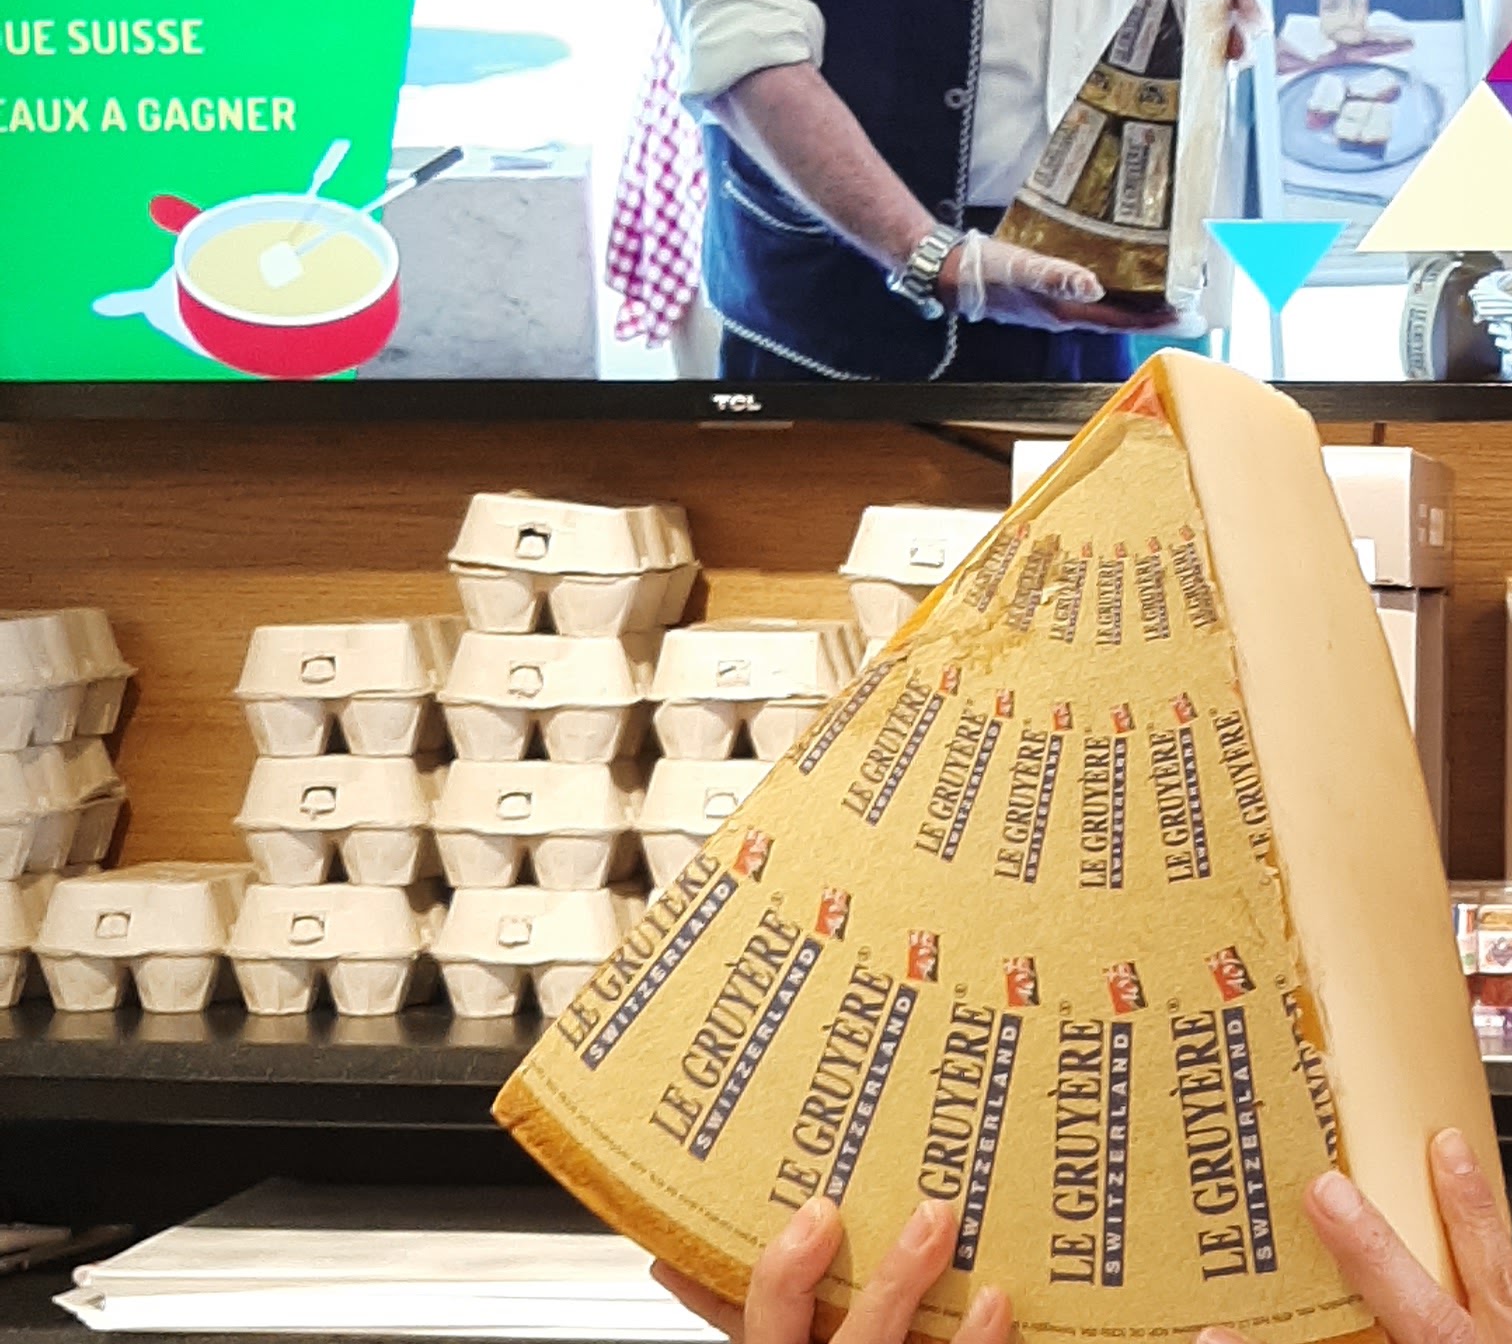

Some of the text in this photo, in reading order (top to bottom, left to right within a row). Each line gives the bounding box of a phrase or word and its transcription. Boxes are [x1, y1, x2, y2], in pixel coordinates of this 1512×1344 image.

[0, 18, 205, 56] UE SUISSE
[101, 97, 128, 133] A
[137, 96, 297, 134] GAGNER
[712, 393, 763, 412] TCL
[841, 675, 934, 818] LE GRUYÈRE
[913, 707, 989, 856] LE GRUYÈRE
[994, 727, 1049, 879] LE GRUYÈRE
[1077, 735, 1110, 889] LE GRUYÈRE
[1148, 728, 1195, 885] LE GRUYÈRE
[555, 998, 601, 1051] LE
[588, 880, 734, 1064] SWITZERLAND
[650, 907, 802, 1146] LE GRUYÈRE
[694, 942, 819, 1155] SWITZERLAND
[768, 962, 894, 1212] LE GRUYÈRE
[825, 989, 915, 1202] WITZERLAND
[917, 1001, 995, 1202] GRUYÈRE
[956, 1019, 1021, 1263] SWITZERLAND
[1046, 1017, 1104, 1286] LE GRUYÈRE
[1104, 1029, 1131, 1277] SWITZERLAND
[1169, 1008, 1249, 1282] LE GRUYÈRE
[1225, 1014, 1275, 1264] SWITZERLAND
